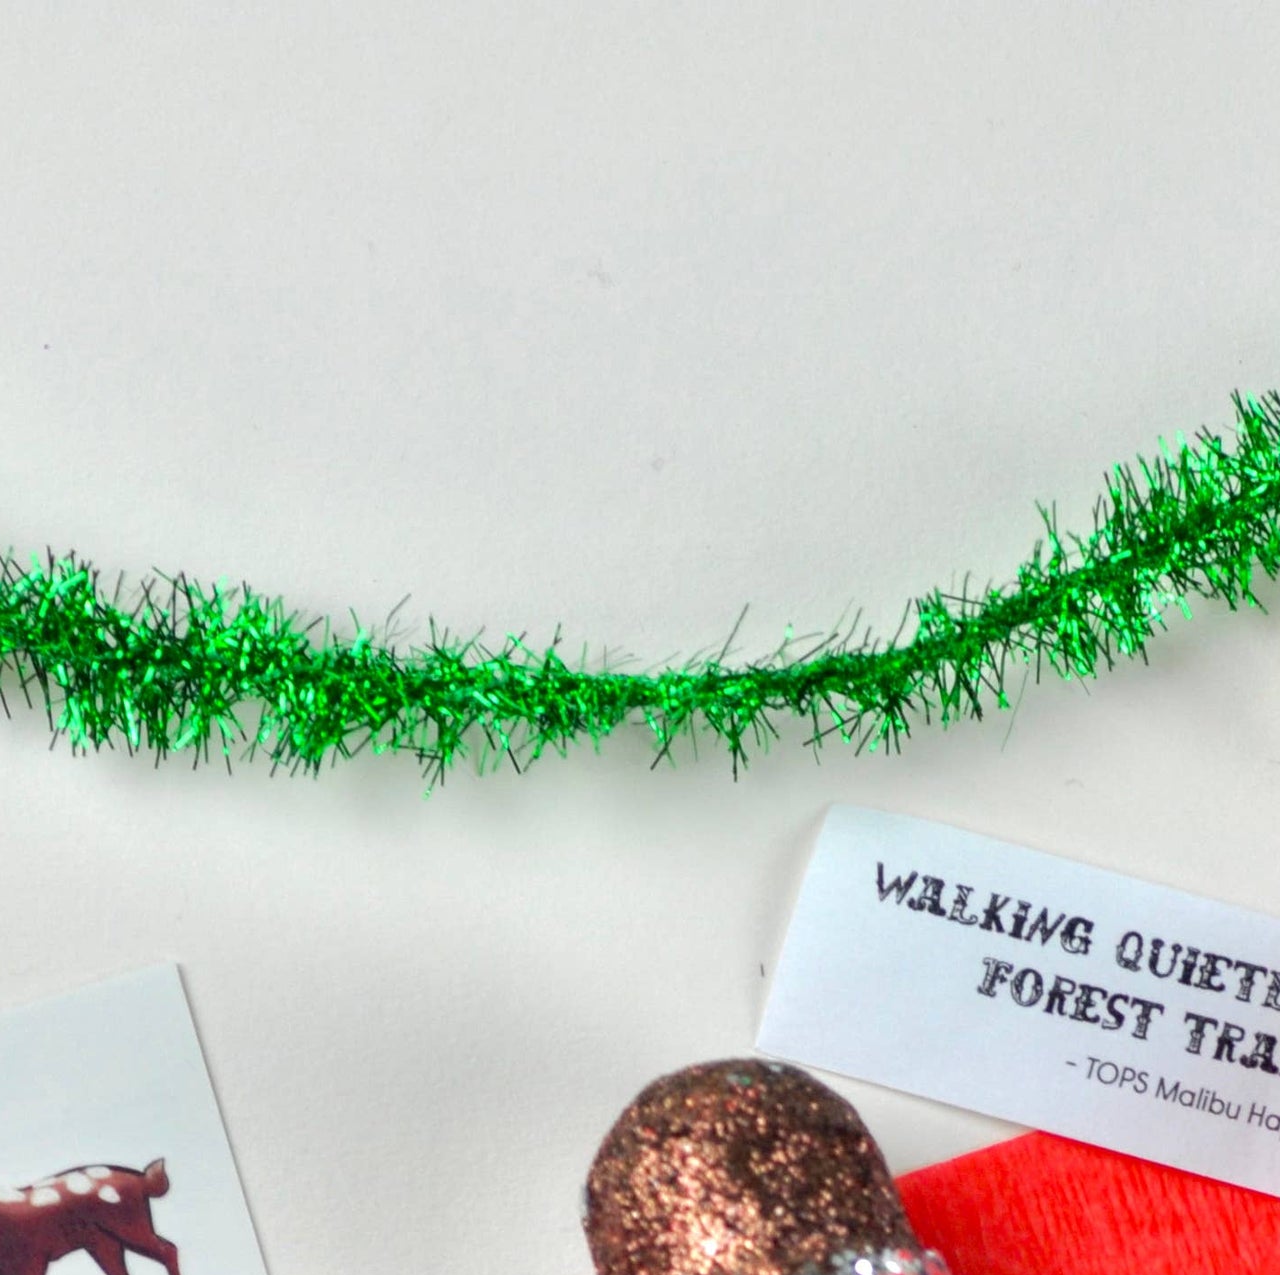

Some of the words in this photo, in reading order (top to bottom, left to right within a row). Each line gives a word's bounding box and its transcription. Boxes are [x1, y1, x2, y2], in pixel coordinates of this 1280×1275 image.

[873, 861, 1093, 956] WALKING
[978, 956, 1164, 1042] FOREST
[1086, 1057, 1149, 1094] TOPS
[1155, 1078, 1241, 1120] Malibu
